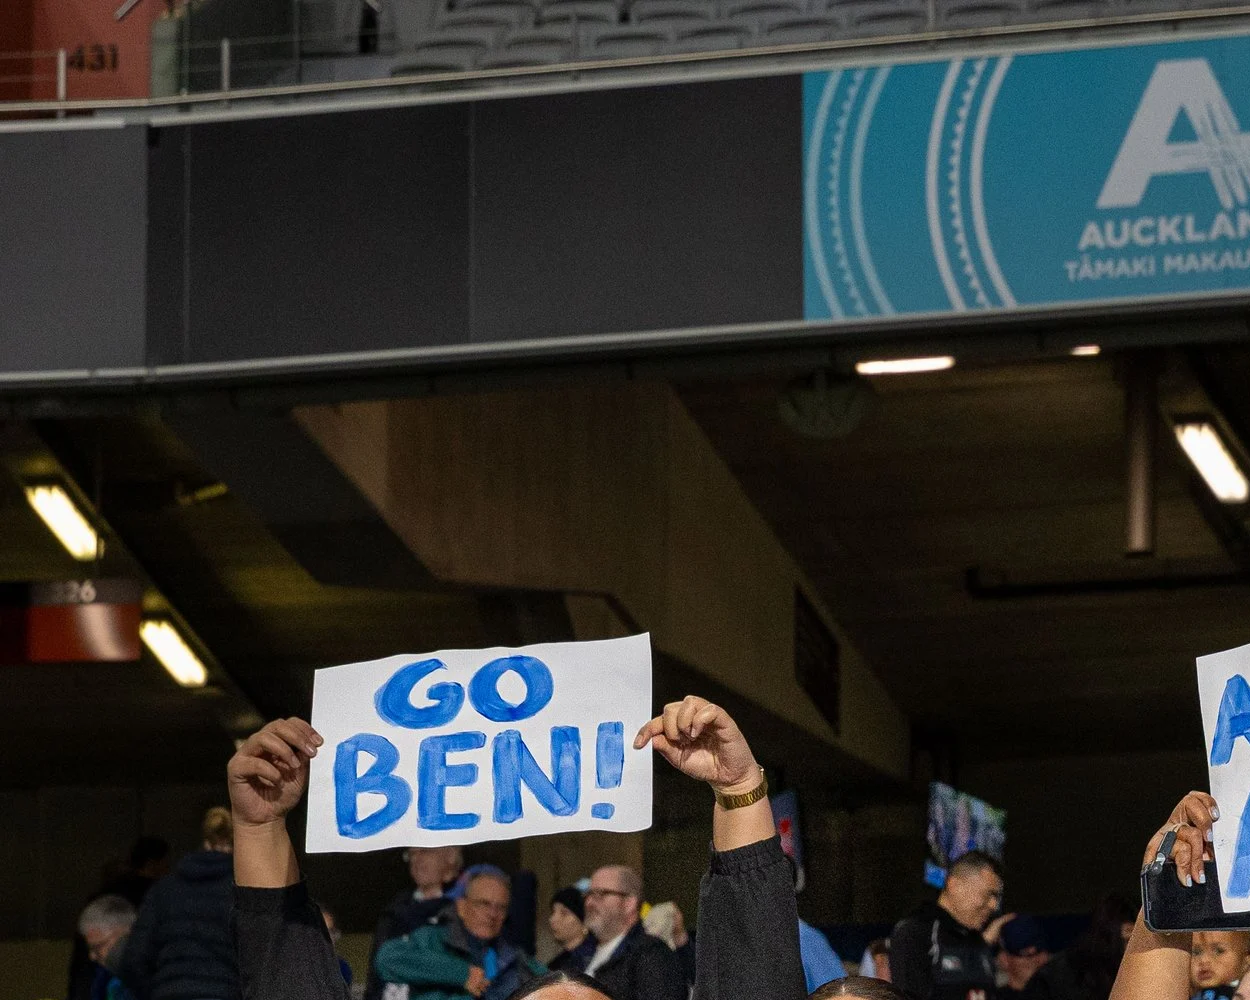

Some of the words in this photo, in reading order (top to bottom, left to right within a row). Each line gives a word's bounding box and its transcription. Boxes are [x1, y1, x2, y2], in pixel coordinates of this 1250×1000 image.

[67, 44, 118, 71] 431
[373, 655, 555, 730] GO
[333, 721, 625, 840] BEN!
